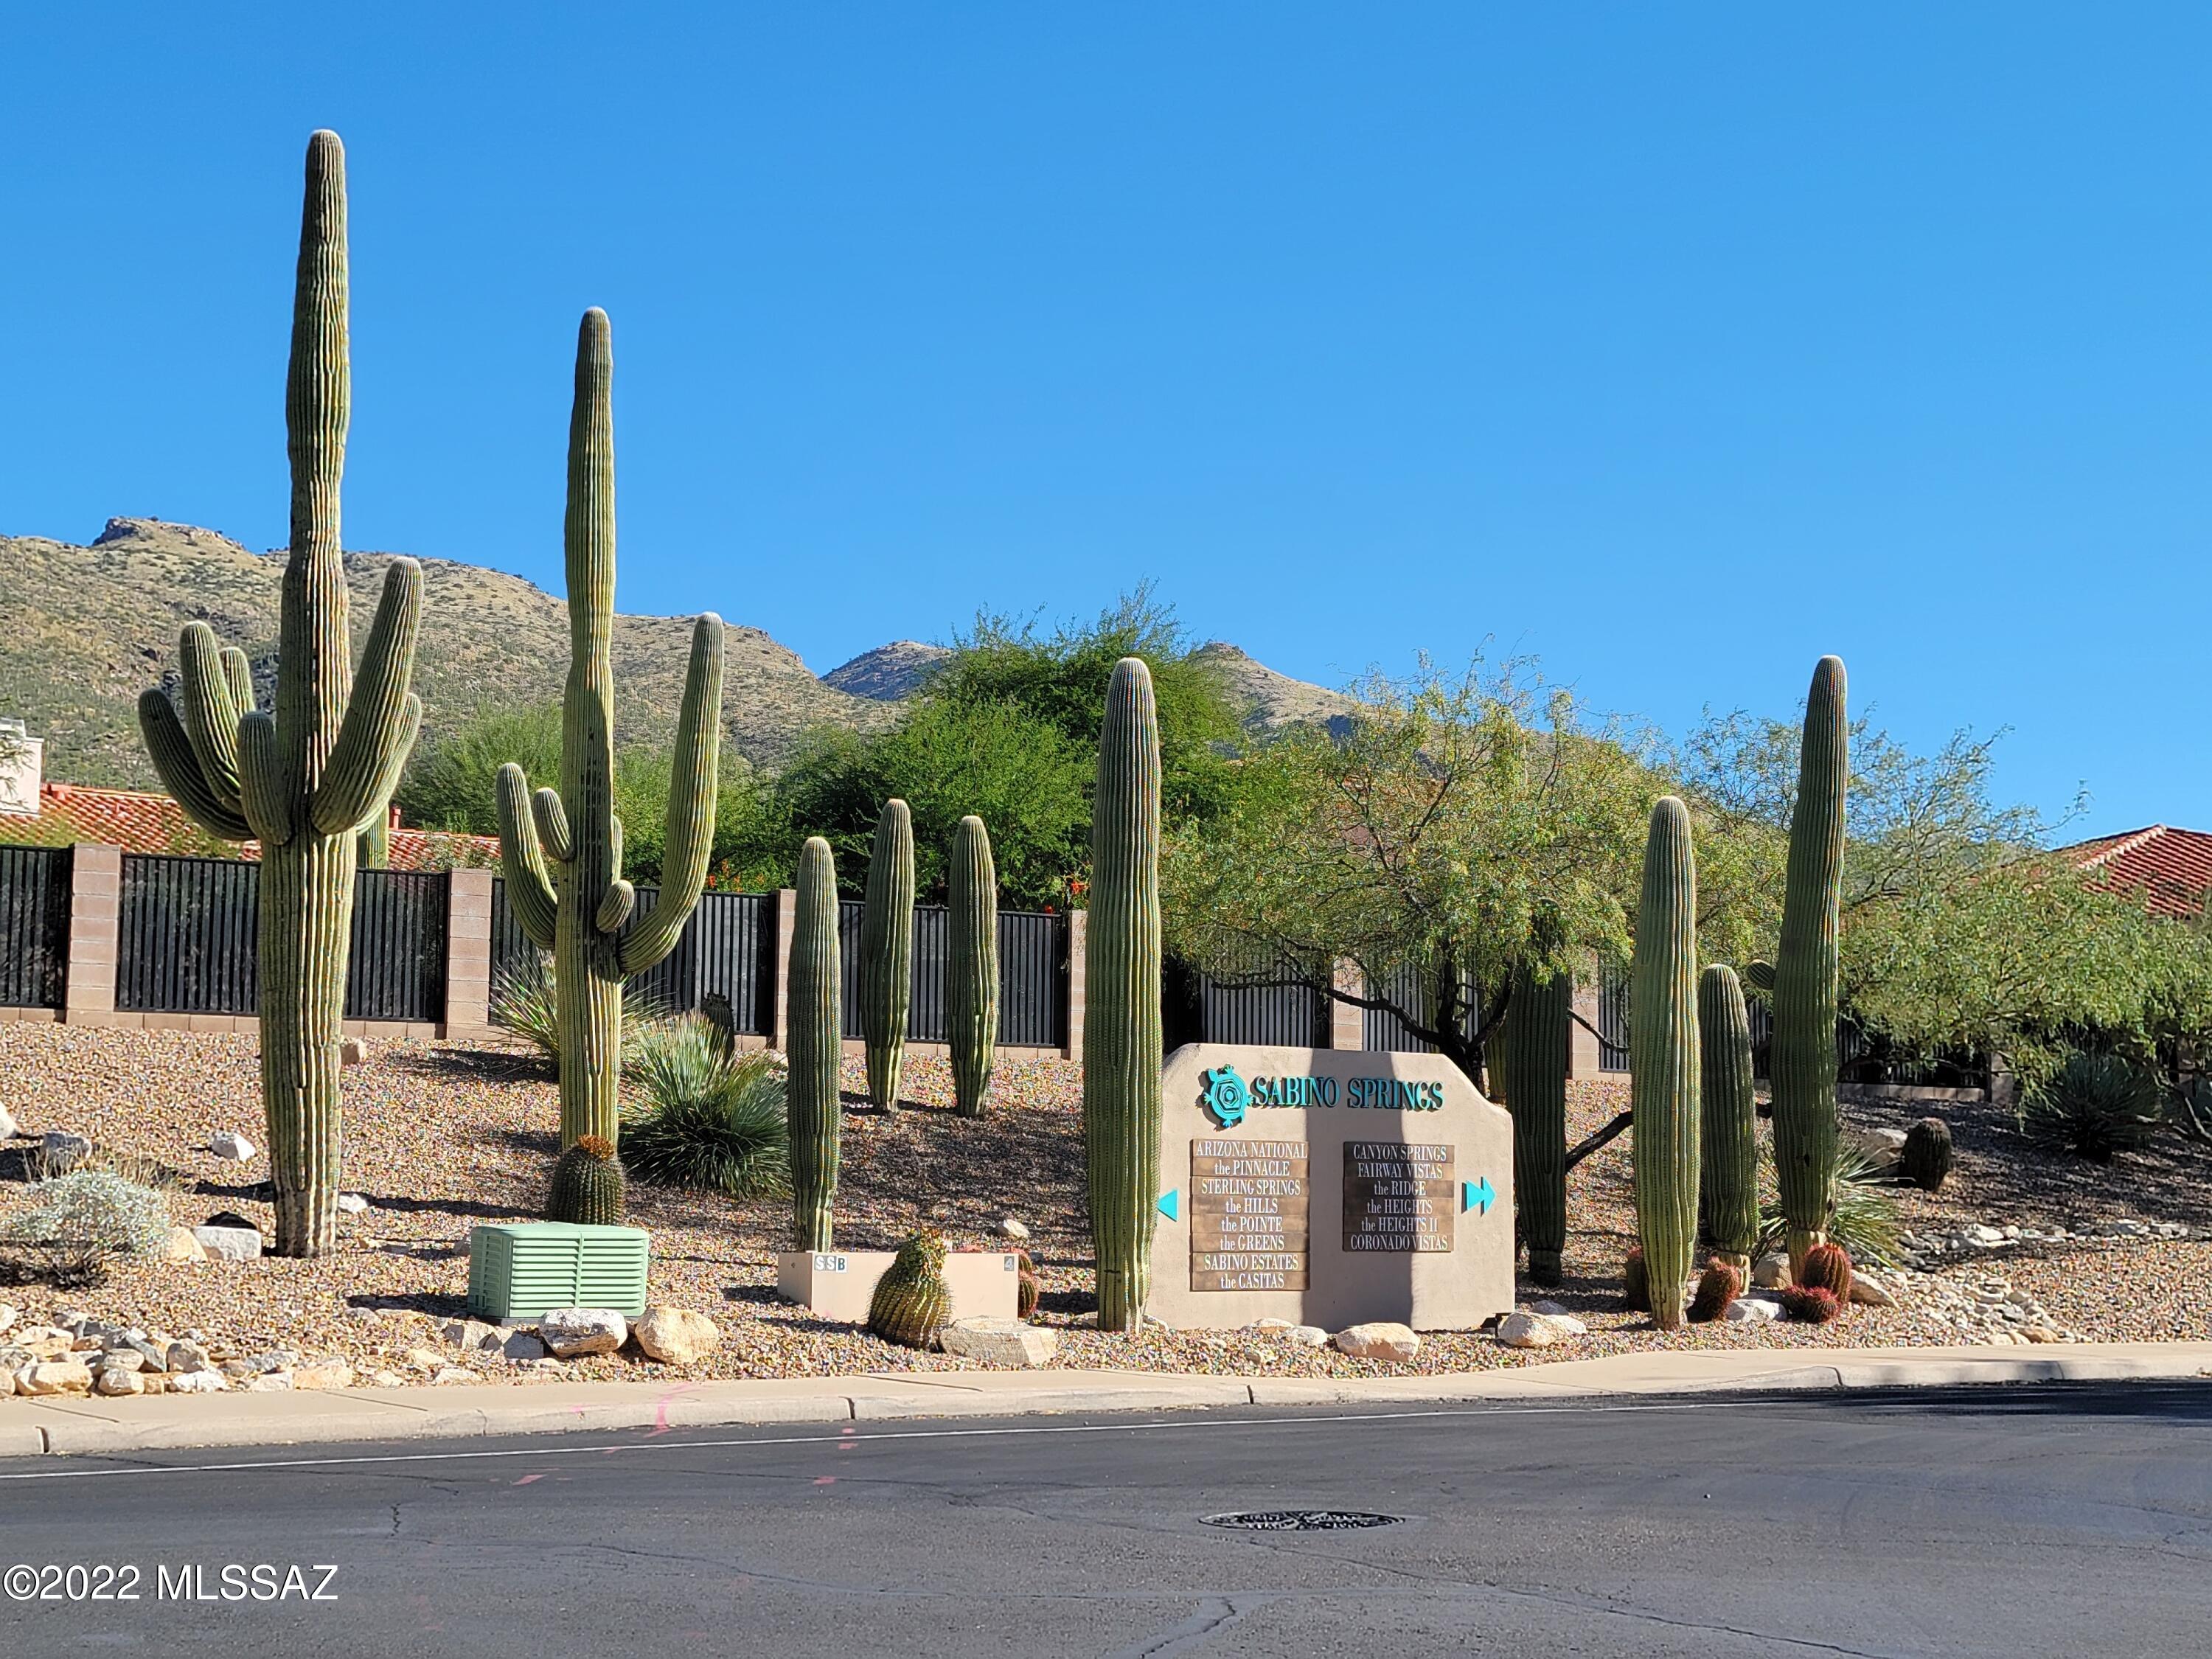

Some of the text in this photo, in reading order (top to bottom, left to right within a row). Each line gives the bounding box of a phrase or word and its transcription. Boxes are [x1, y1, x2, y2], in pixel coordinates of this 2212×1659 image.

[1254, 1076, 1444, 1110] SABINO SPRINGS
[1197, 1141, 1307, 1158] ARIZONA NATIONAL
[1354, 1144, 1447, 1161] CANYON SPRINGS
[1214, 1160, 1290, 1176] the PINNACLE
[1358, 1163, 1443, 1178] FAIRWAY VISTAS
[1202, 1178, 1301, 1195] STERLING SPRINGS
[1374, 1181, 1426, 1195] the RIDGE
[1225, 1198, 1278, 1213] the HILLS
[1367, 1199, 1433, 1214] the HEIGHTS
[1221, 1217, 1282, 1232] the POINTE
[1362, 1217, 1438, 1232] the HEIGHTS II
[1220, 1235, 1284, 1251] the GREENS
[1351, 1234, 1447, 1251] CORONADO VISTAS
[815, 1256, 845, 1270] SSB
[1204, 1254, 1298, 1270] SABINO ESTATES
[1221, 1273, 1284, 1289] the CASITAS
